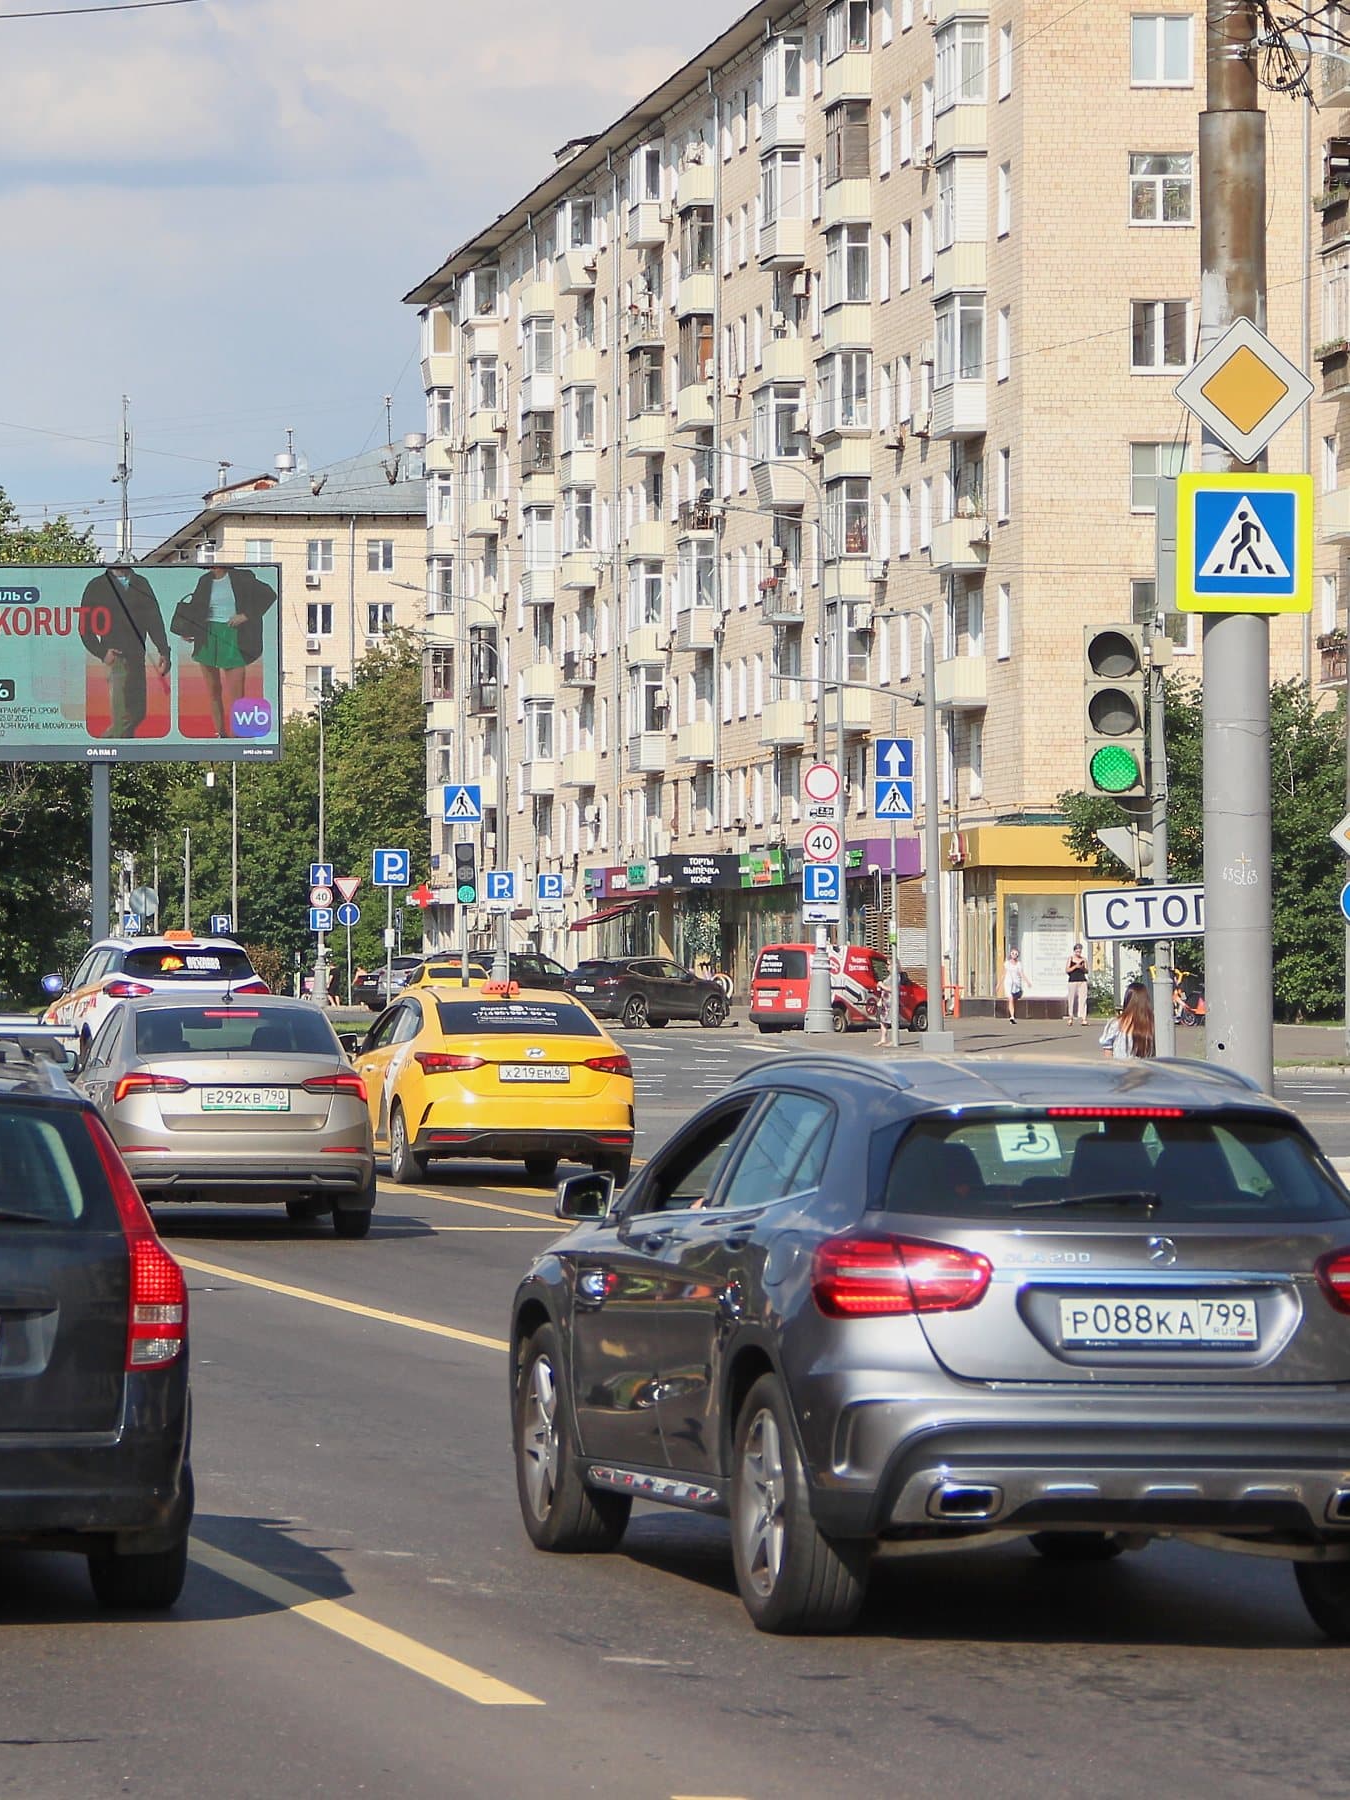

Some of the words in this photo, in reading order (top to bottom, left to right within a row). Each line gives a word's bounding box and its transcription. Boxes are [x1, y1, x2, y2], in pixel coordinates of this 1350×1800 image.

[24, 591, 33, 601] С
[234, 705, 269, 726] wb
[812, 835, 833, 850] 40
[688, 857, 714, 866] ТОРТЫ
[682, 866, 720, 875] ВЫПЕЧКА
[690, 875, 713, 884] КОФЕ
[315, 892, 328, 900] 40
[1072, 1304, 1195, 1335] Р088КА
[1200, 1303, 1247, 1327] 799
